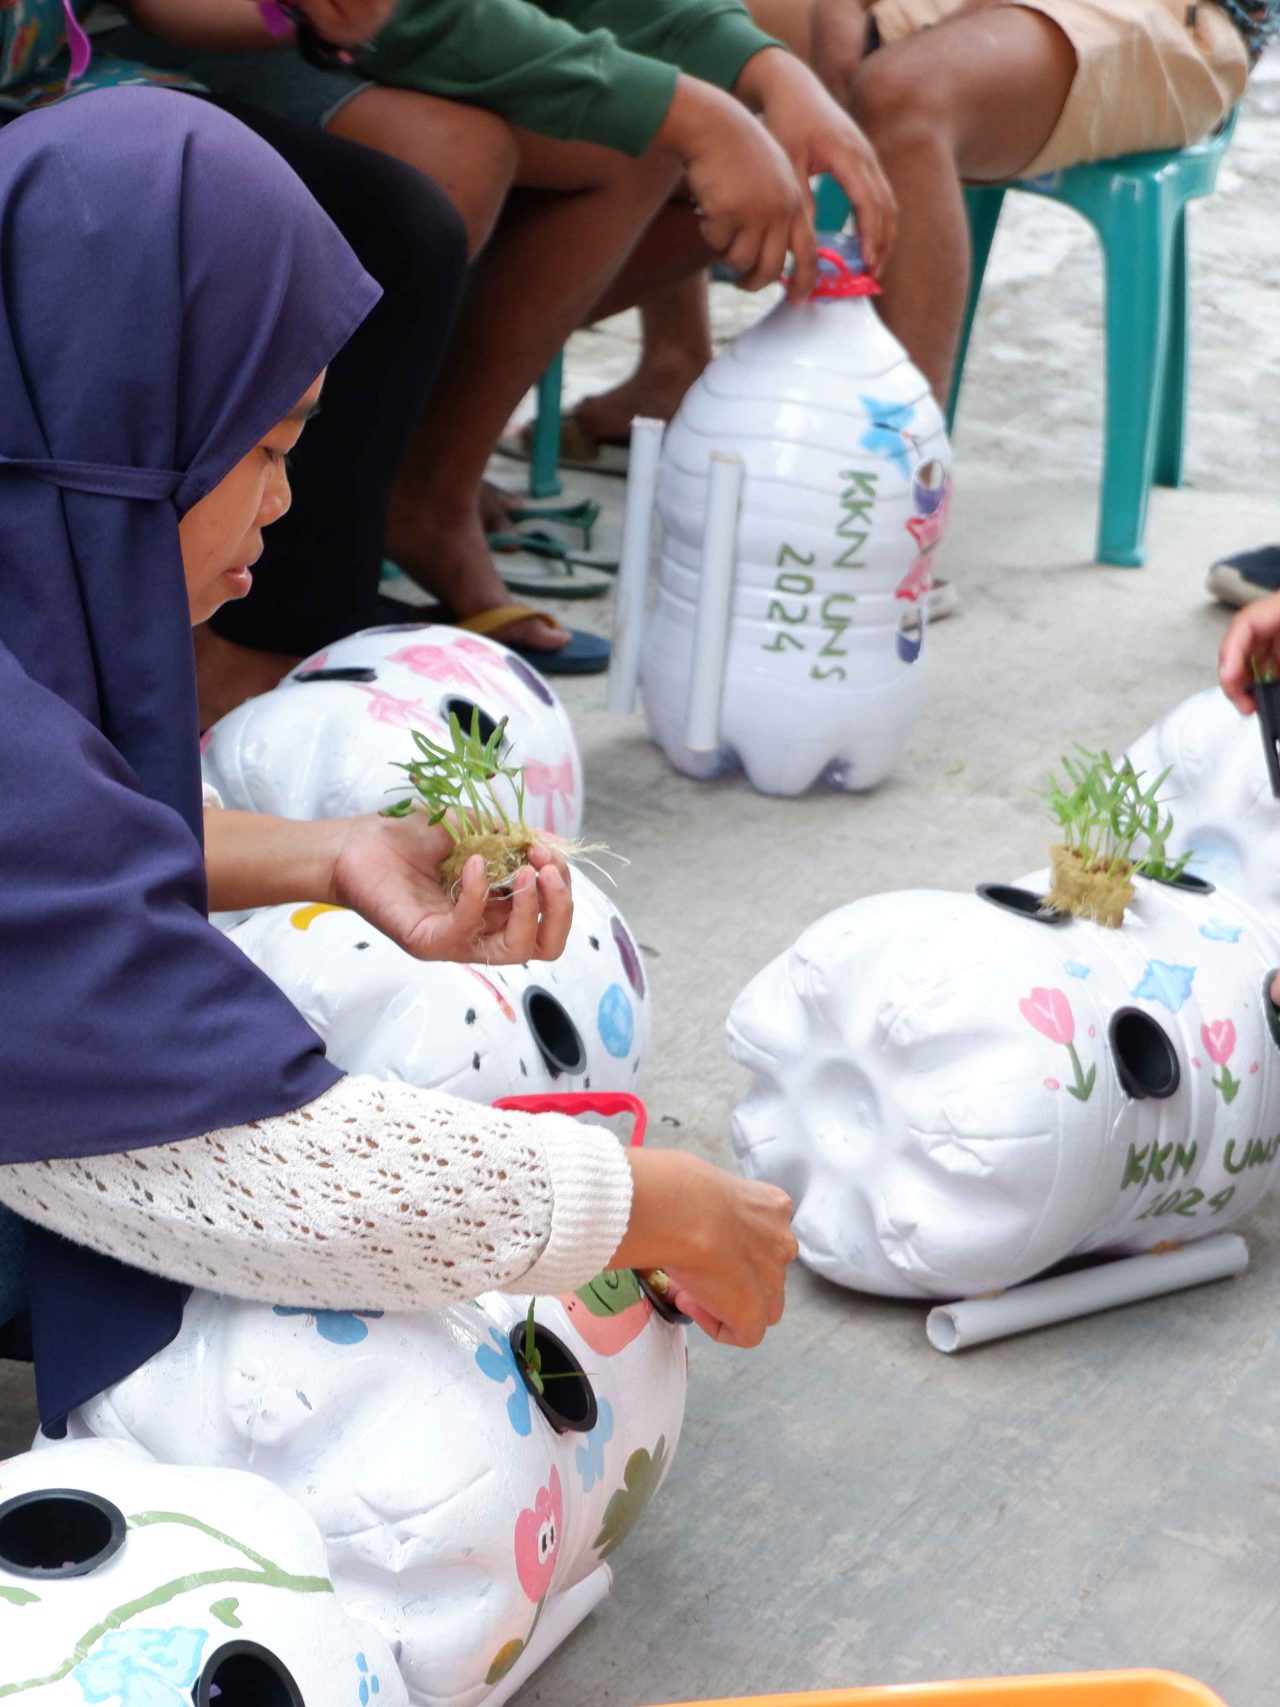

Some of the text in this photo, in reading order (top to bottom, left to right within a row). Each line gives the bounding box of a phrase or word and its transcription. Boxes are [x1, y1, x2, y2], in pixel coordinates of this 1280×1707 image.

[762, 543, 815, 652] 2024
[811, 470, 878, 681] KKN UNS
[1121, 1139, 1197, 1190] KKN
[1135, 1185, 1236, 1221] 2024
